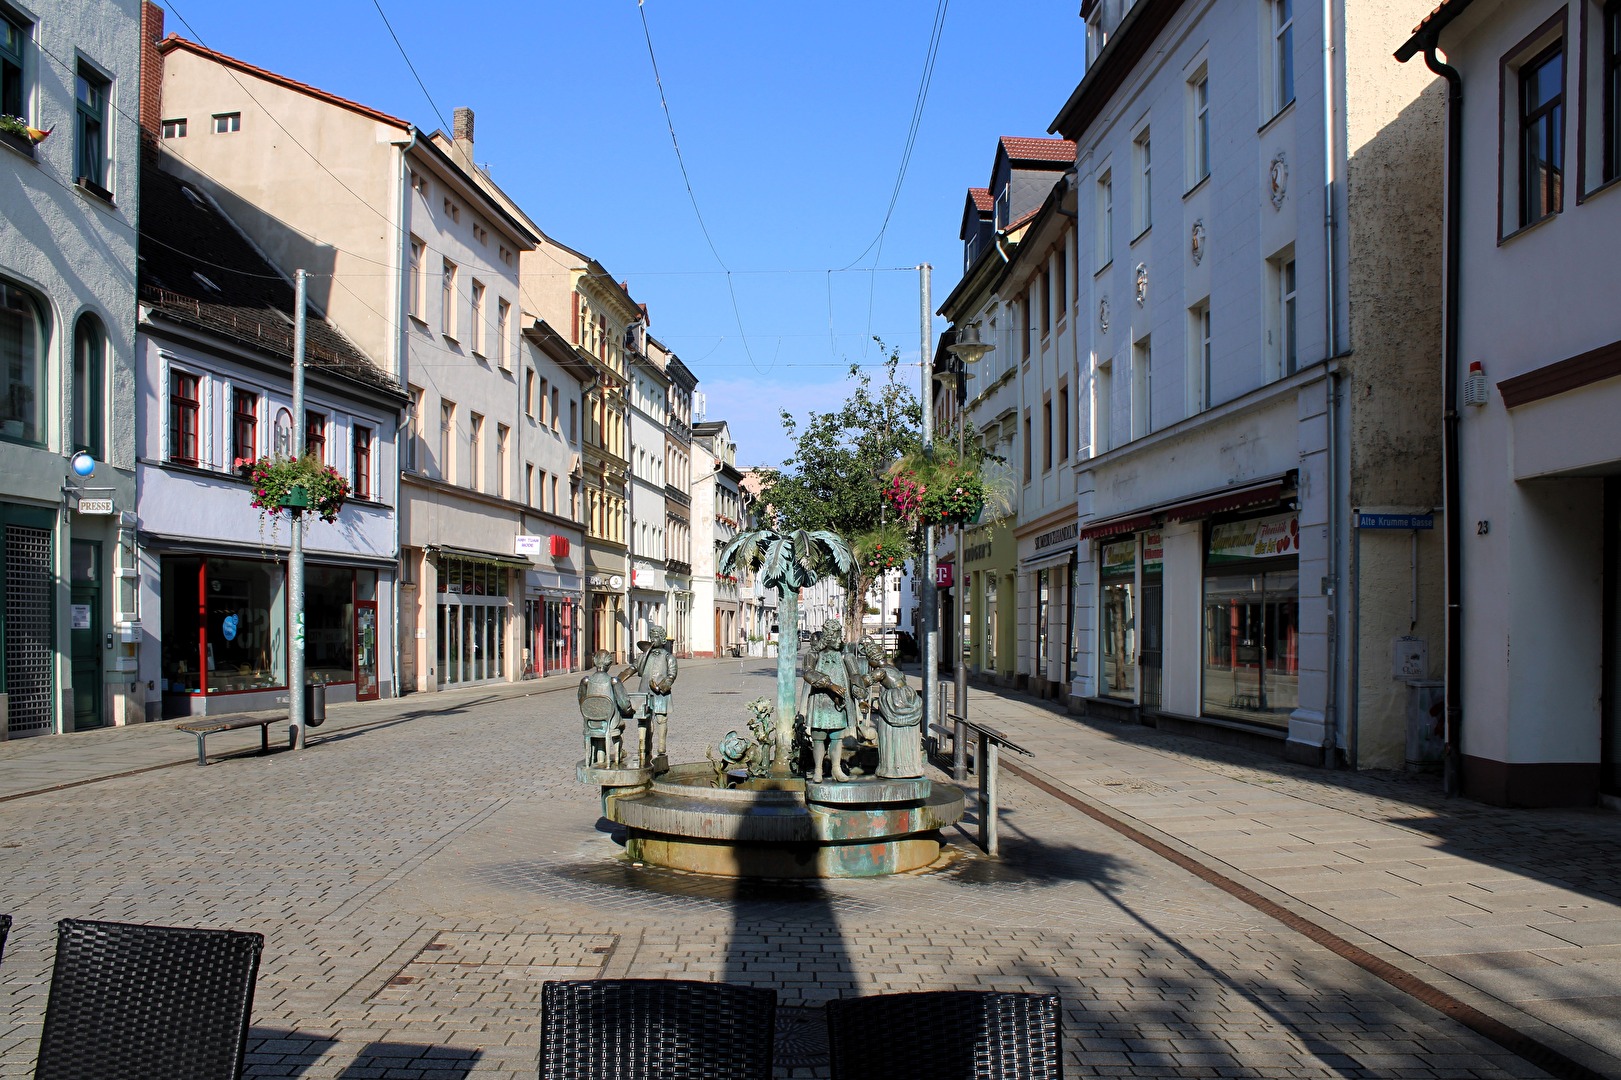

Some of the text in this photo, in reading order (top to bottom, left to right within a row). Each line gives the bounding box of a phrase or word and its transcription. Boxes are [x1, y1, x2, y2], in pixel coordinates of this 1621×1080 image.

[80, 501, 112, 511] PRESSE
[1360, 517, 1432, 528] Alte Krumme Gasse
[1477, 520, 1490, 535] 23
